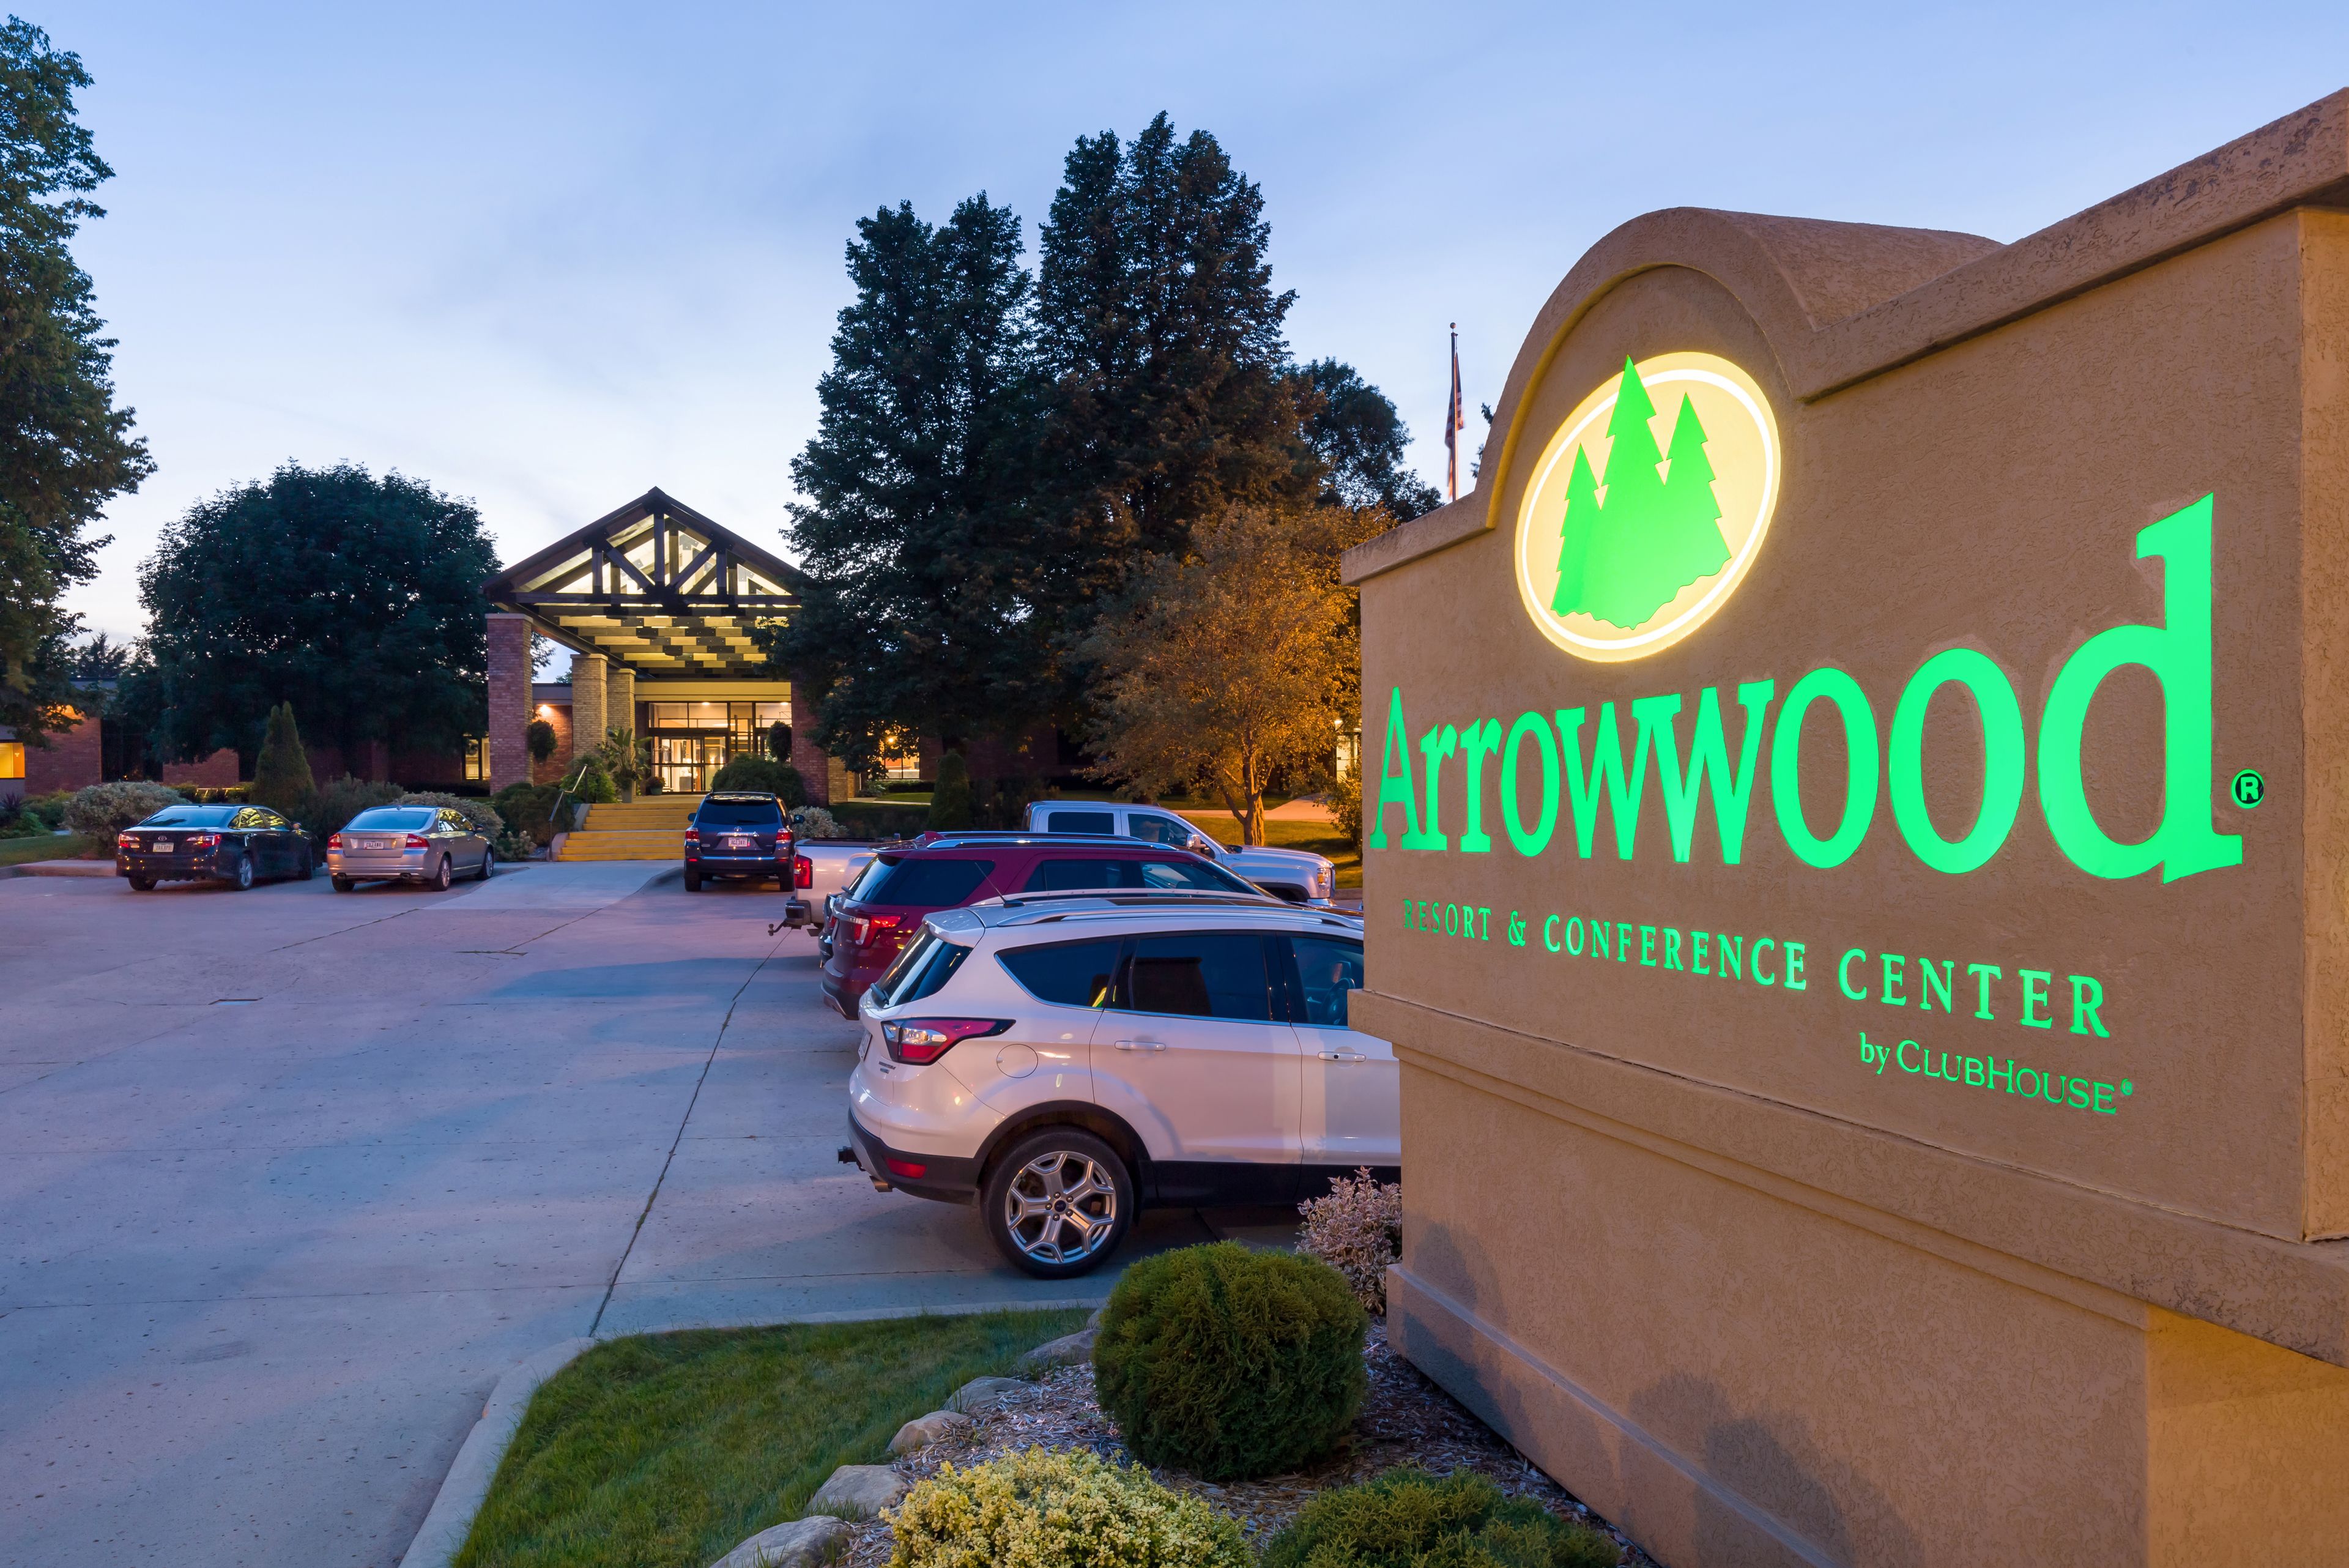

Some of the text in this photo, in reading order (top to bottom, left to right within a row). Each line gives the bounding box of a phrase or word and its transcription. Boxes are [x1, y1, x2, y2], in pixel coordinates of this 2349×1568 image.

[1403, 898, 2111, 1039] RESORT & CONFERENCE CENTER
[1858, 1031, 1891, 1075] by
